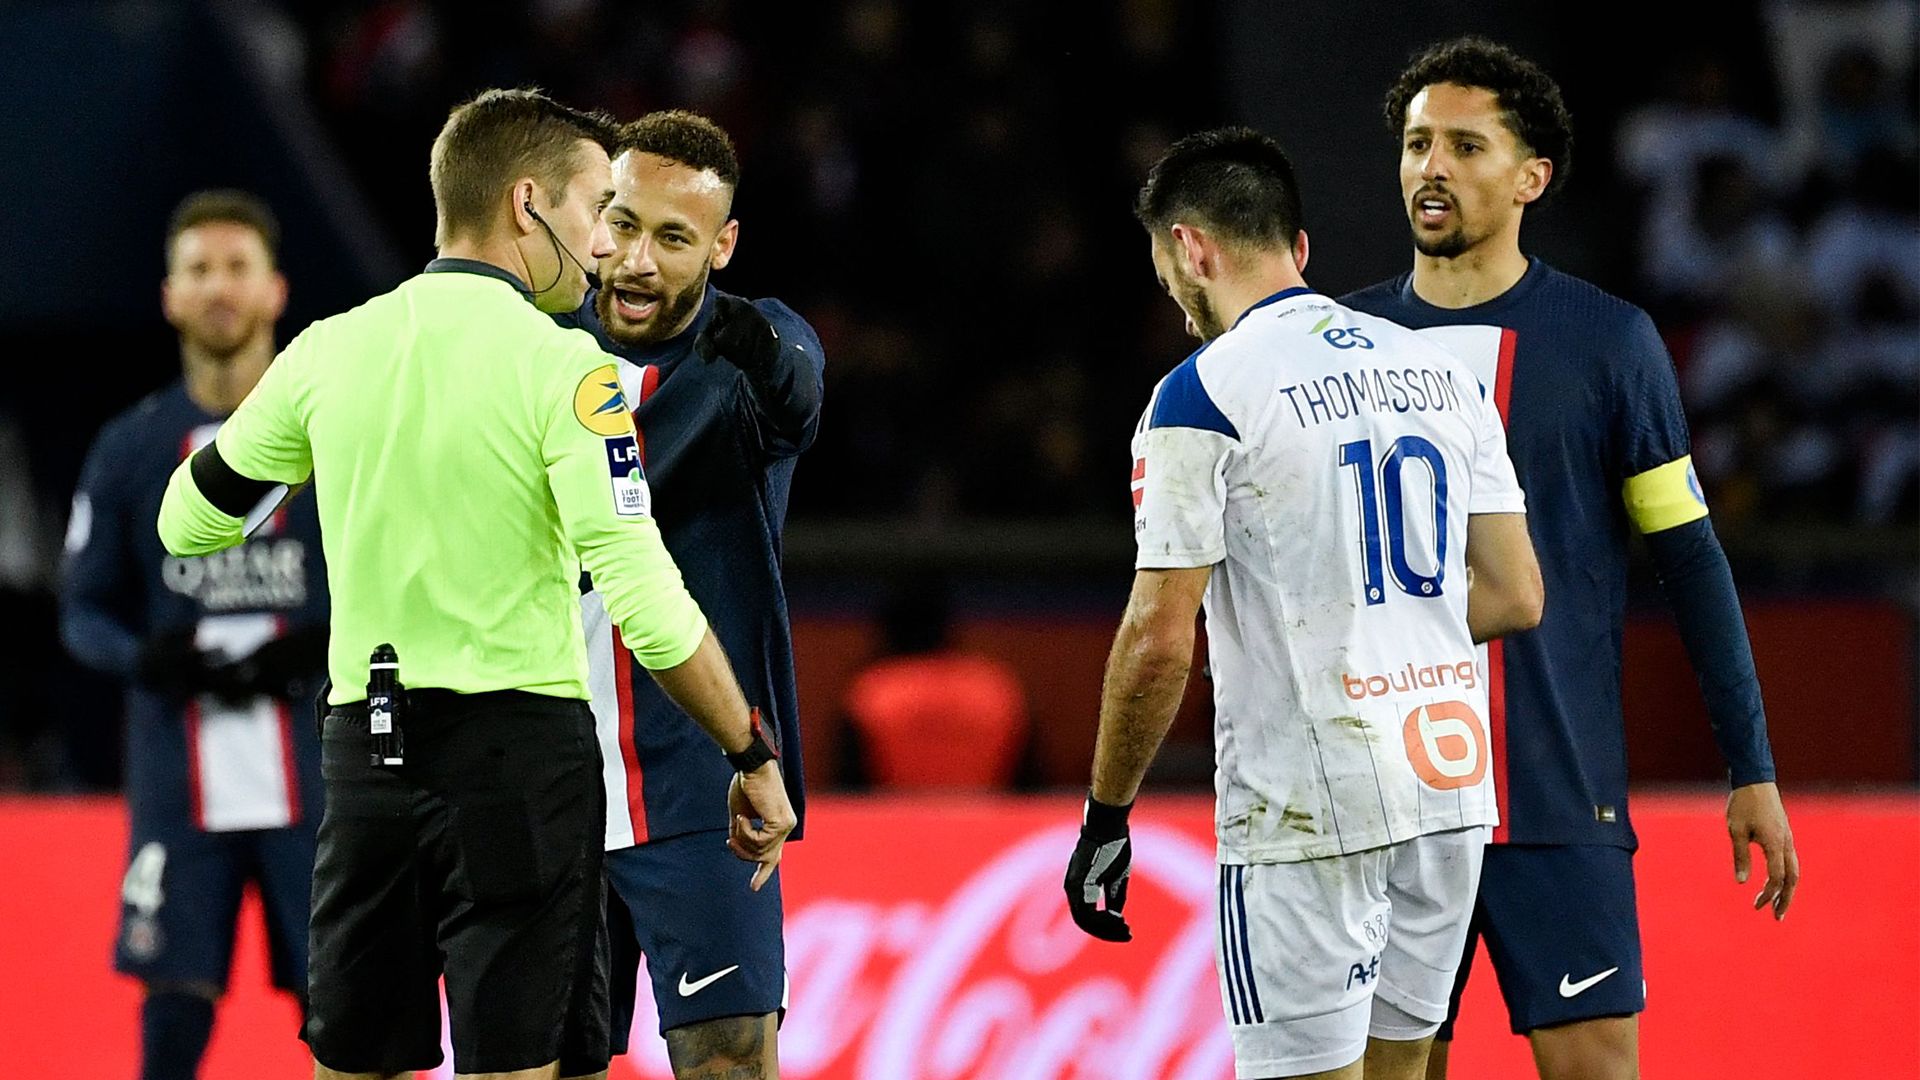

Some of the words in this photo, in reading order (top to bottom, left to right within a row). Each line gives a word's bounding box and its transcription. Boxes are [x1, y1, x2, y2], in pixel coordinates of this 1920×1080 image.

[1279, 368, 1460, 428] THOMASSON
[612, 446, 638, 462] LF
[1339, 436, 1448, 606] 10
[1341, 661, 1478, 700] boulang
[370, 696, 389, 707] LFP
[1346, 954, 1381, 991] At
